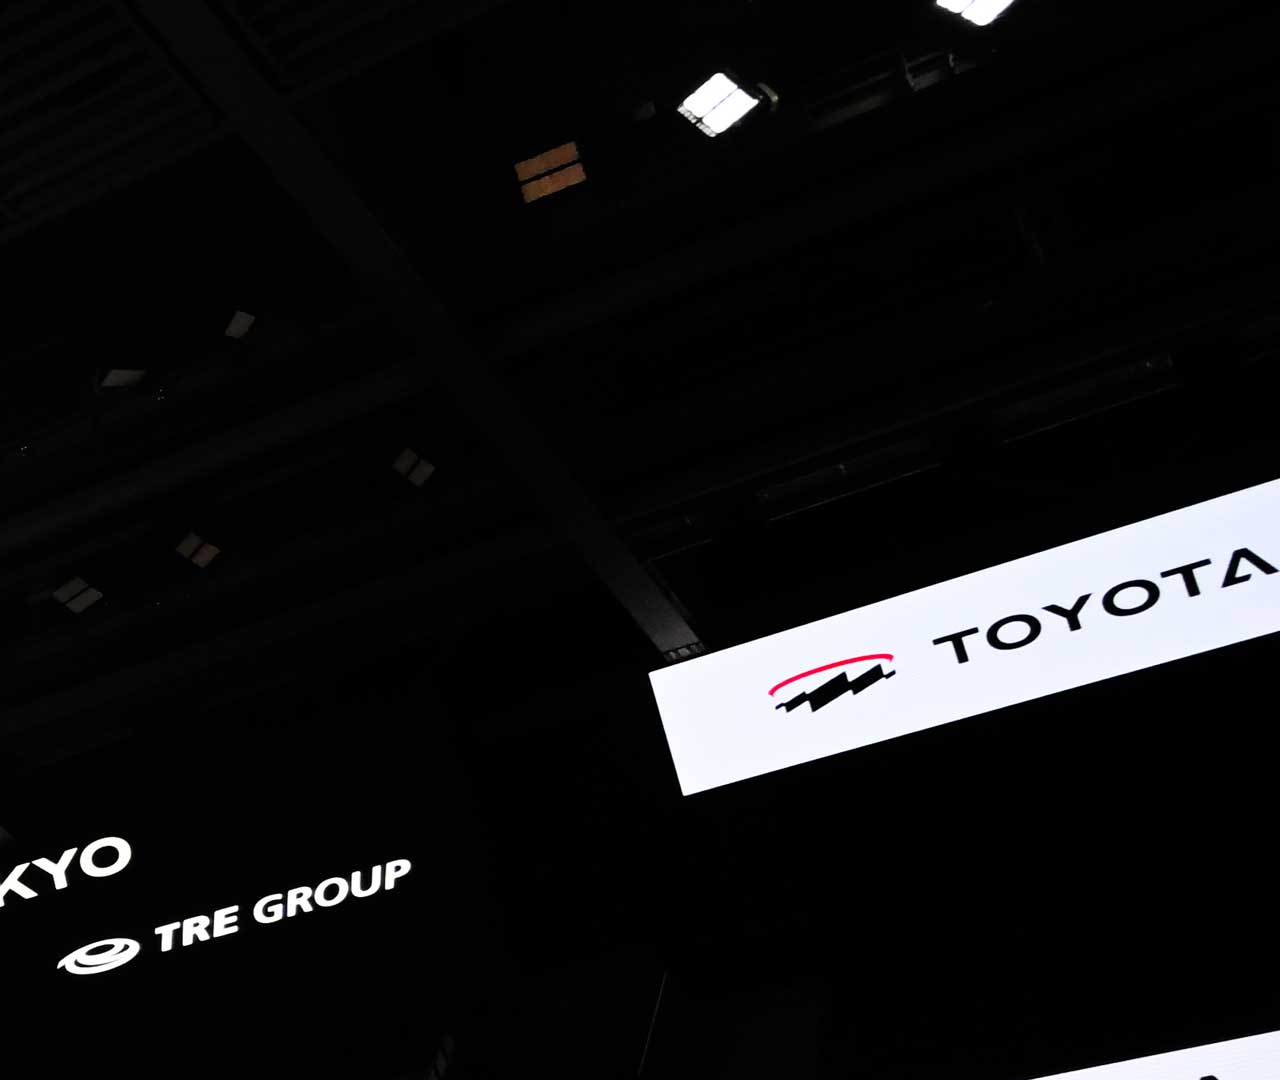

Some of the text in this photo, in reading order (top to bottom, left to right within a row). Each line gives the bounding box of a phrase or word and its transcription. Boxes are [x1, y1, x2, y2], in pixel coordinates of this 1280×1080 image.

[932, 547, 1280, 664] TOYOTA
[154, 858, 412, 952] TRE GROUP
